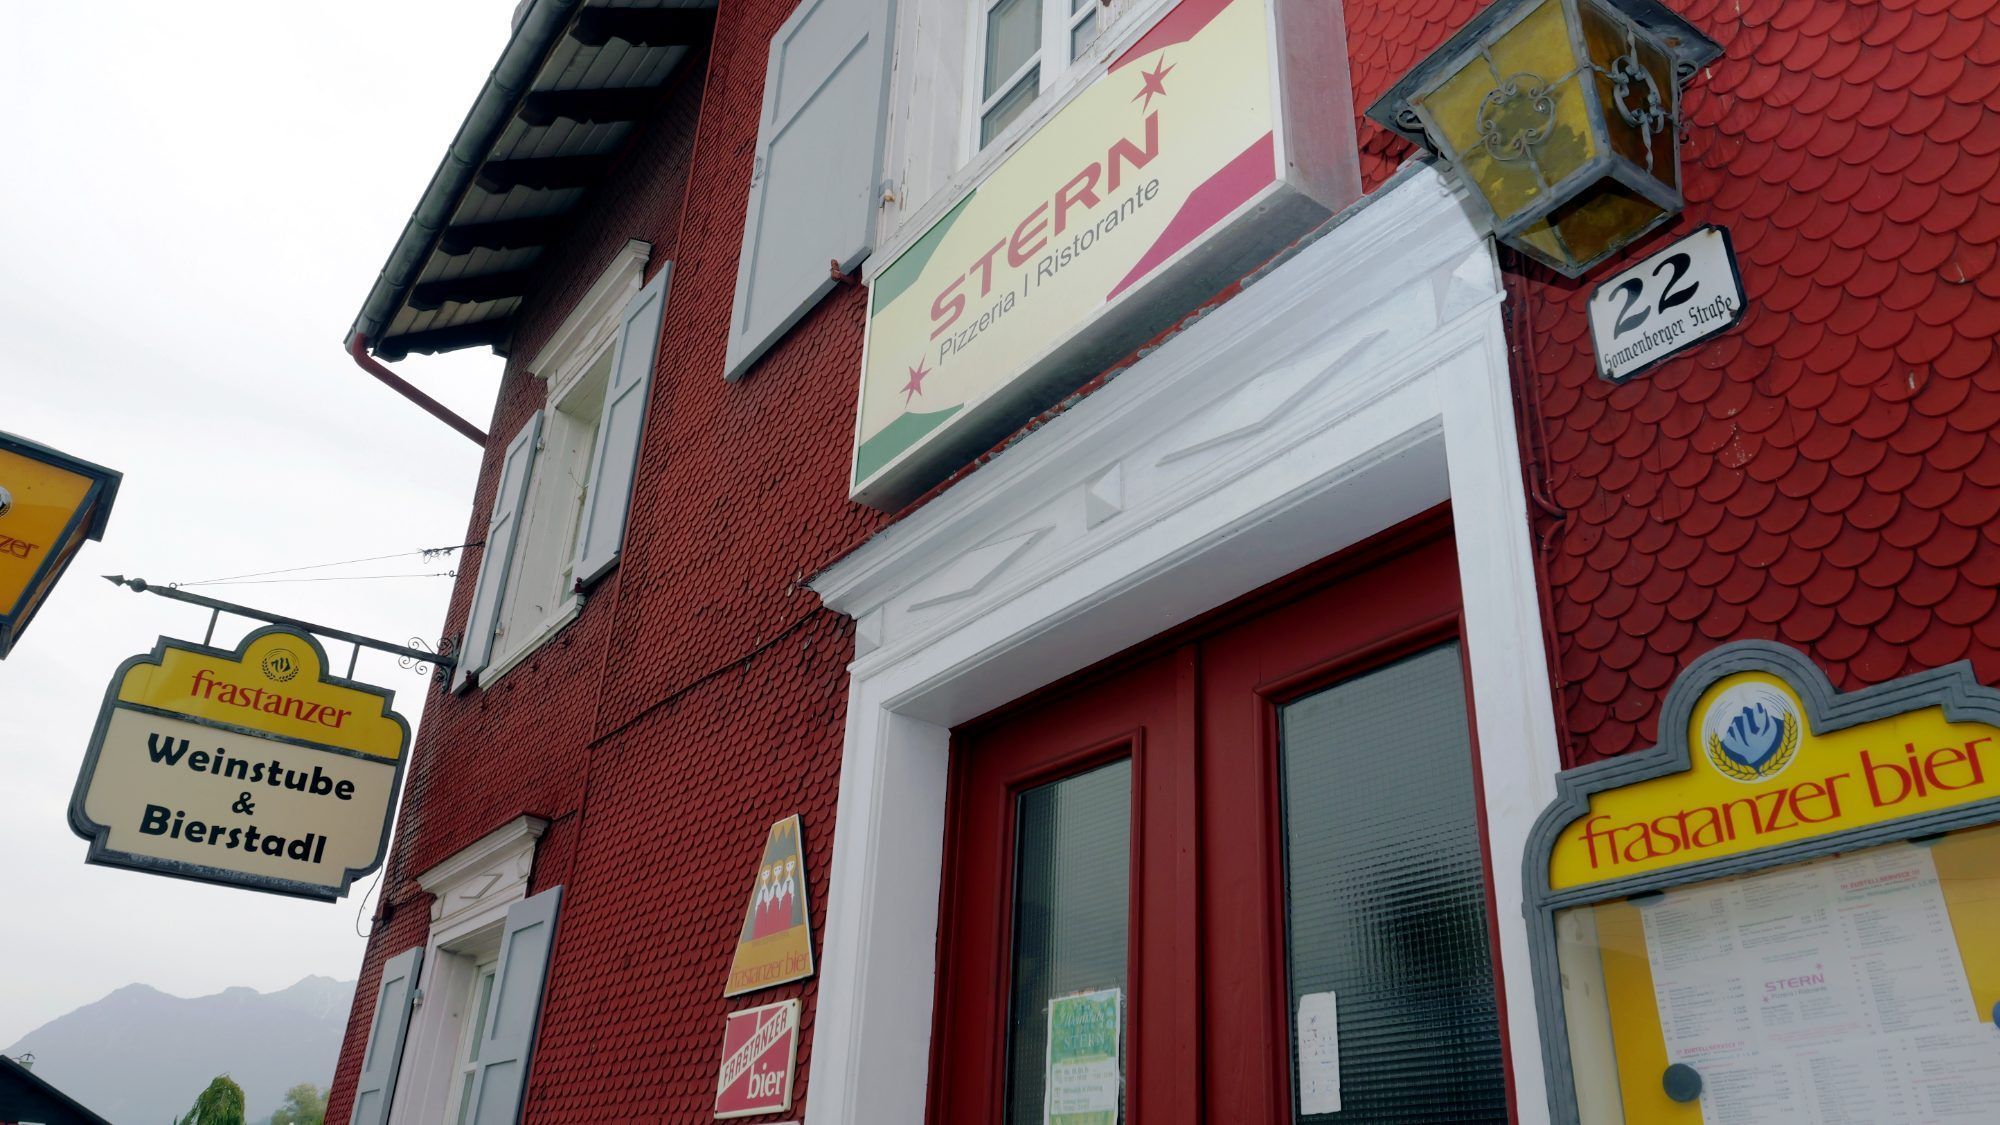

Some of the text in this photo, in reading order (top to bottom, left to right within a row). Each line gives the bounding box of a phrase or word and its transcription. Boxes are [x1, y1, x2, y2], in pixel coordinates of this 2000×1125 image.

[930, 110, 1160, 343] STERN
[938, 292, 1016, 367] Pizzeria
[1036, 178, 1160, 288] Ristorante
[1608, 252, 1700, 341] 22
[1604, 295, 1733, 371] Sonnenberger Straße
[191, 669, 352, 729] frastanzer
[147, 732, 356, 802] Weinstube
[139, 803, 327, 864] Bierstadl
[231, 791, 256, 816] &
[1578, 736, 1993, 869] frastanzer bier
[1764, 973, 1825, 993] STERN
[747, 1056, 785, 1100] bier
